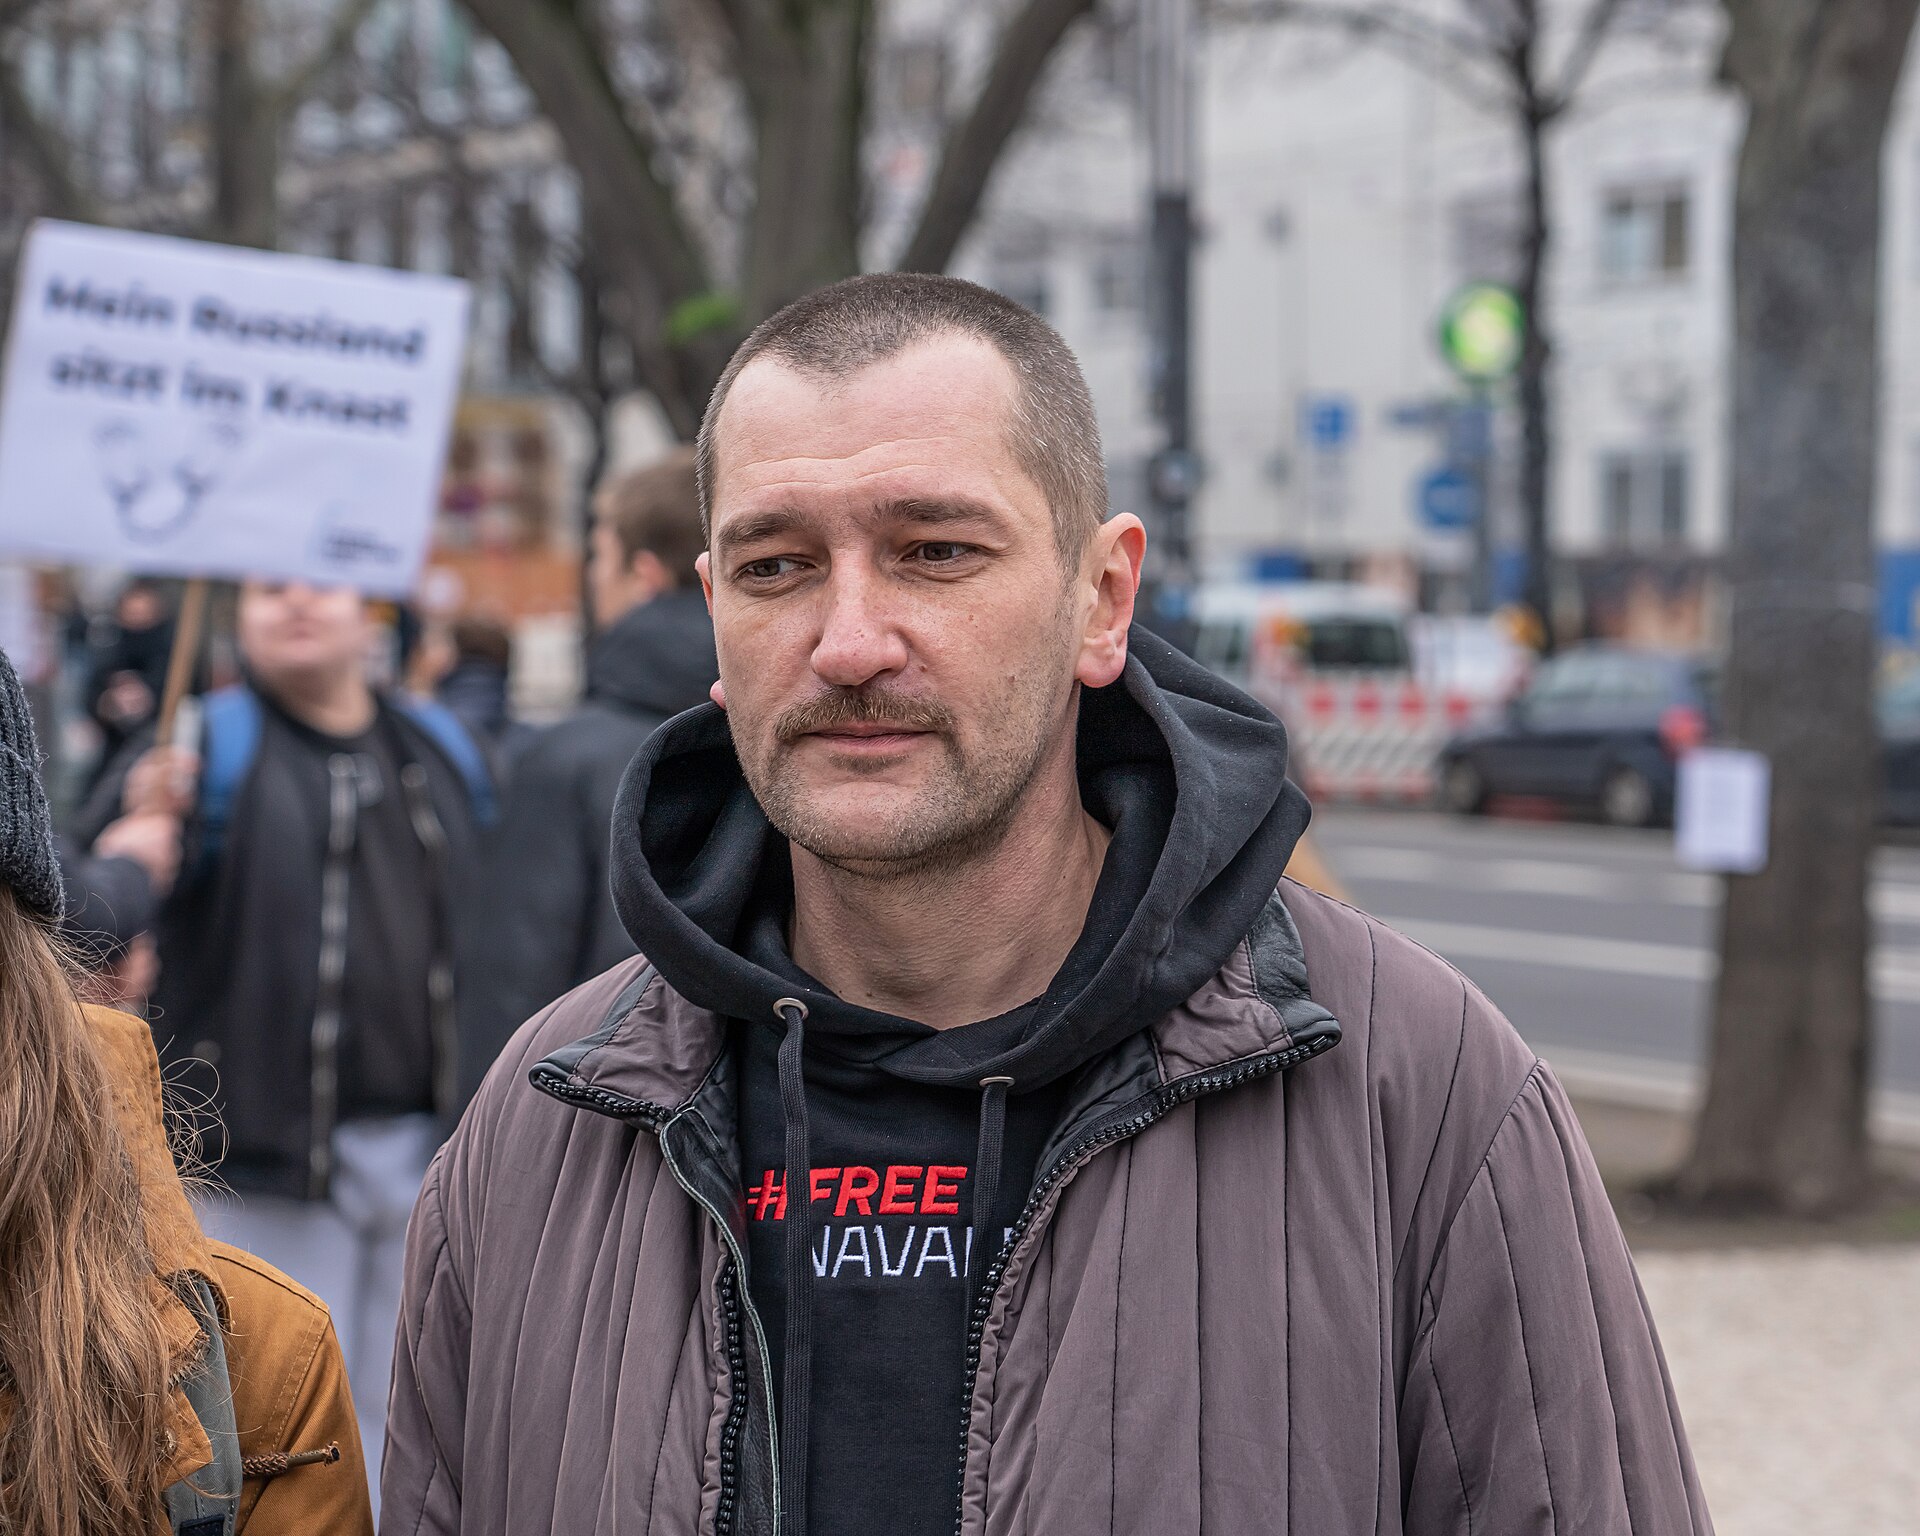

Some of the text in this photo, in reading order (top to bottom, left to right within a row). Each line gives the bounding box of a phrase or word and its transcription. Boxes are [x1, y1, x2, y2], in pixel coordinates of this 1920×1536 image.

[46, 277, 426, 362] Mein Russland
[51, 349, 408, 430] sitzt im Knast
[747, 1165, 968, 1221] #FREE
